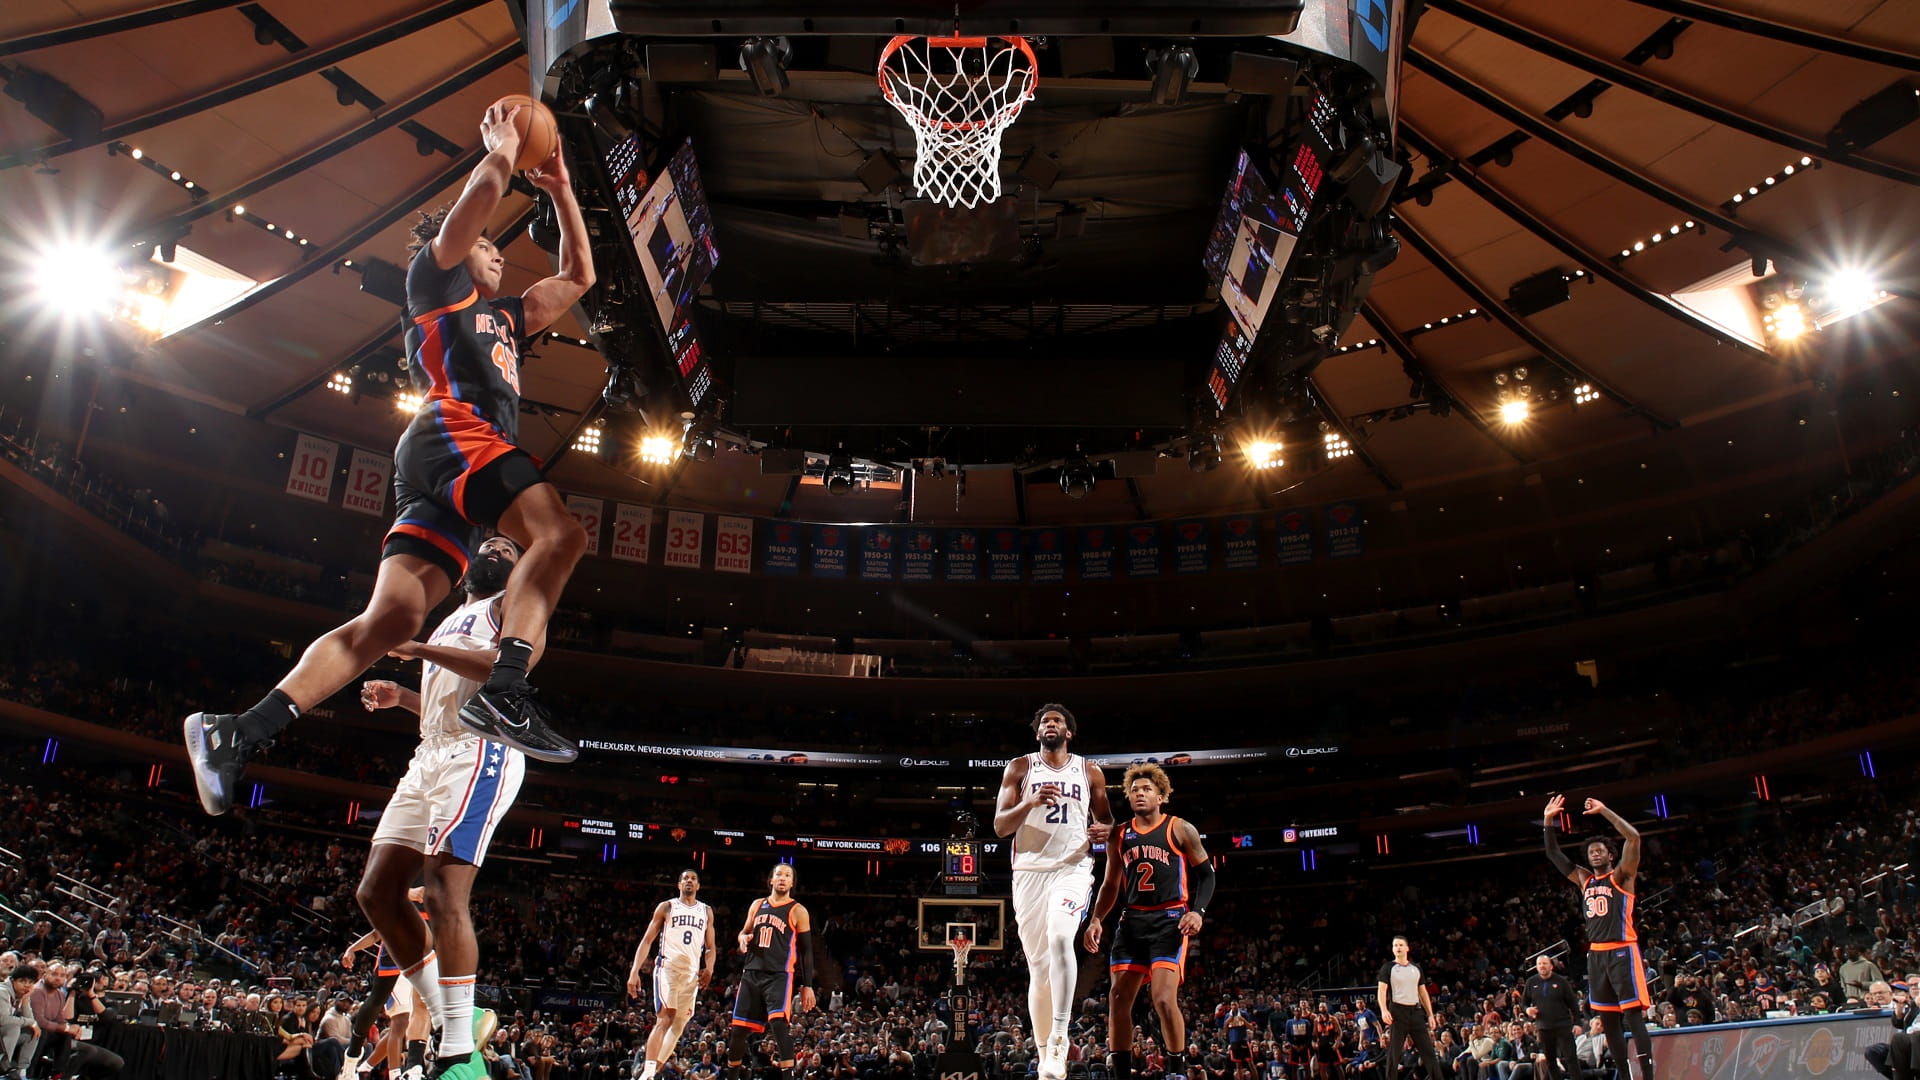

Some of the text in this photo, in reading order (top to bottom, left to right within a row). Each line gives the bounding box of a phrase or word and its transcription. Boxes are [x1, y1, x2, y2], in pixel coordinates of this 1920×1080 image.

[476, 313, 500, 337] NE
[298, 453, 328, 481] 10
[289, 478, 328, 497] KNICKS
[354, 468, 383, 496] 12
[345, 494, 382, 512] KNICKS
[617, 520, 647, 545] 24
[670, 527, 700, 550] 33
[614, 544, 647, 559] KNICKS
[718, 532, 751, 555] 613
[667, 551, 699, 564] KNICKS
[717, 557, 749, 569] KNICKS
[585, 740, 599, 749] THE
[599, 741, 624, 751] LEXUS
[637, 745, 662, 755] NEVER
[662, 747, 681, 756] LOSE
[681, 748, 704, 757] YOUR
[1300, 746, 1339, 755] LEXUS
[1032, 782, 1082, 801] PLA
[1046, 803, 1068, 824] 21
[581, 827, 616, 836] GRIZZLIES
[582, 819, 614, 828] RAPTORS
[724, 837, 732, 846] 9
[816, 840, 834, 849] NEW
[834, 841, 853, 849] YORK
[854, 841, 881, 850] KNICKS
[920, 843, 940, 852] 106
[984, 843, 998, 853] 97
[962, 855, 974, 874] 8
[1141, 845, 1170, 866] YORK
[1136, 861, 1155, 892] 2
[1061, 898, 1078, 910] 76
[1586, 895, 1609, 918] 30
[768, 914, 788, 935] YORK
[682, 930, 694, 945] 8
[758, 925, 774, 949] 11
[577, 999, 605, 1008] ULTRA
[1349, 994, 1376, 1004] UTR
[1855, 1026, 1892, 1047] TUESDAY
